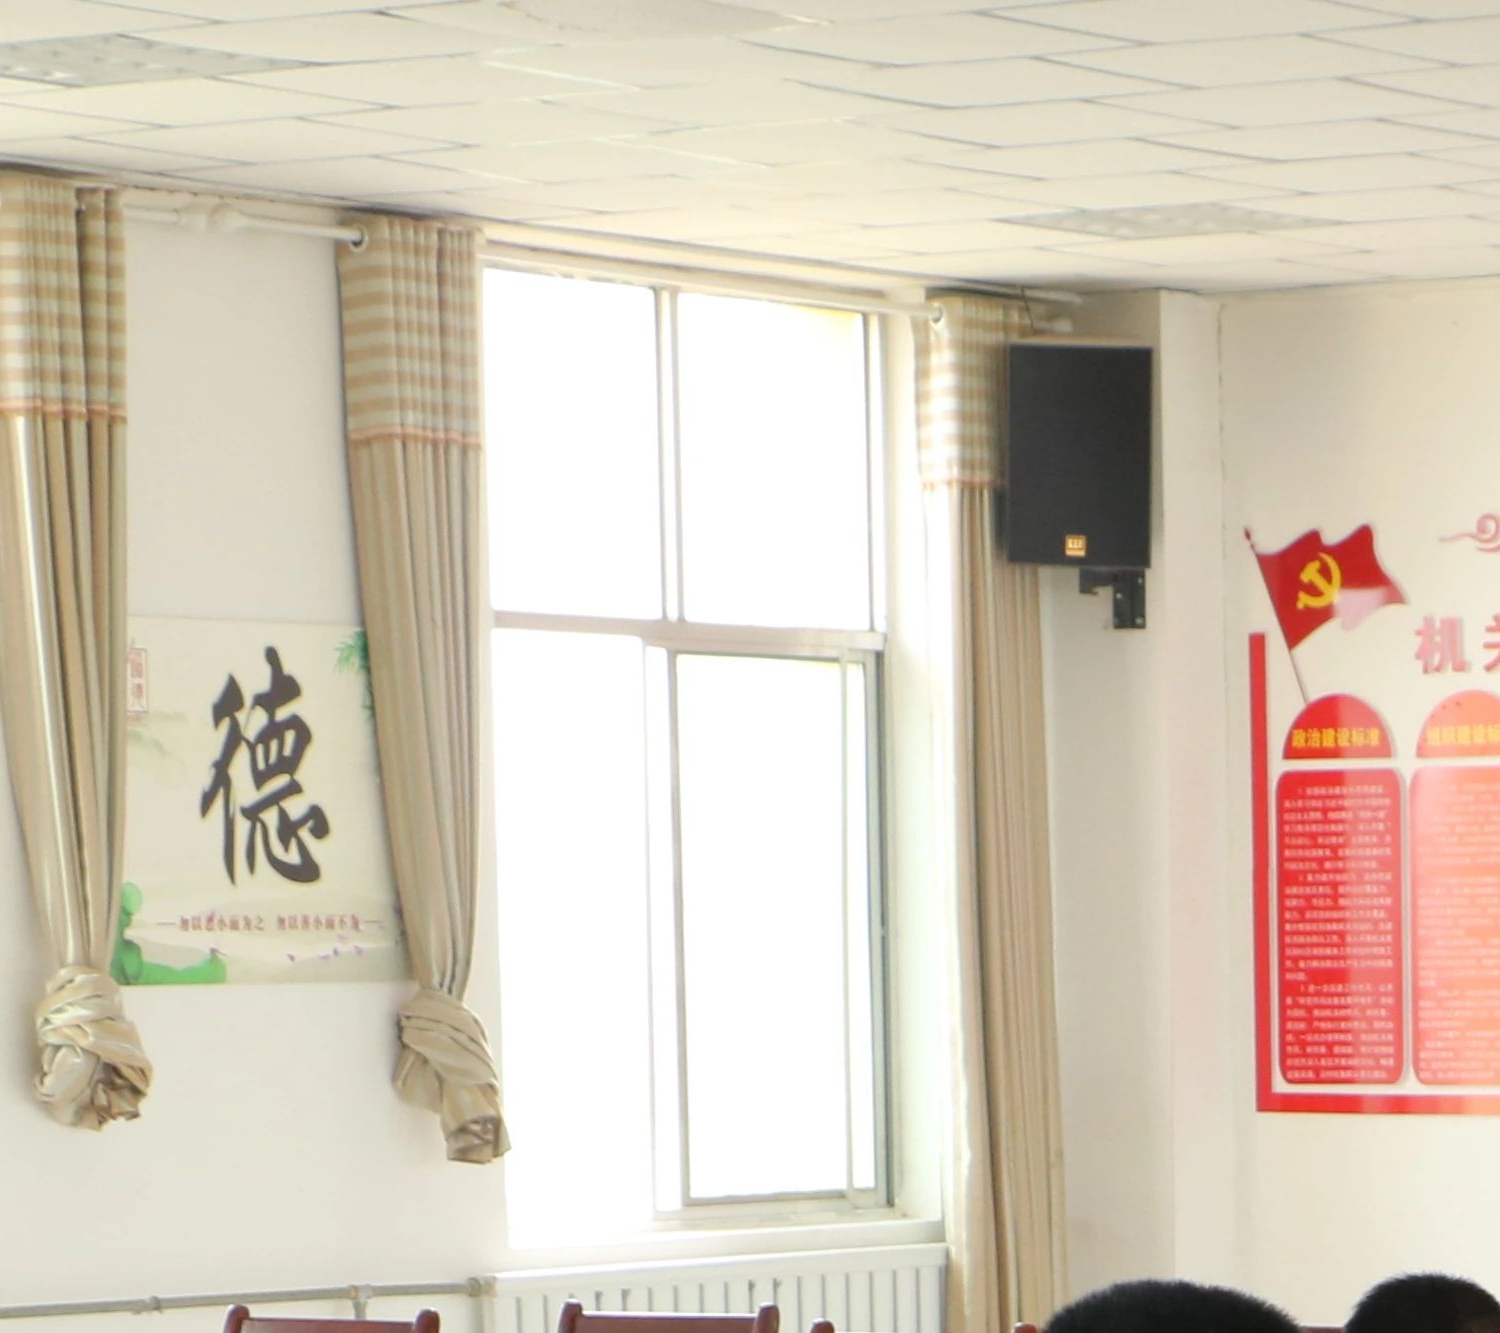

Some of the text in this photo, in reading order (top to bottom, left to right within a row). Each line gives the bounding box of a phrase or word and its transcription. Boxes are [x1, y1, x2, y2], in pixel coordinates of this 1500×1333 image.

[198, 645, 331, 887] 德
[1291, 726, 1381, 749] 政治建设标准
